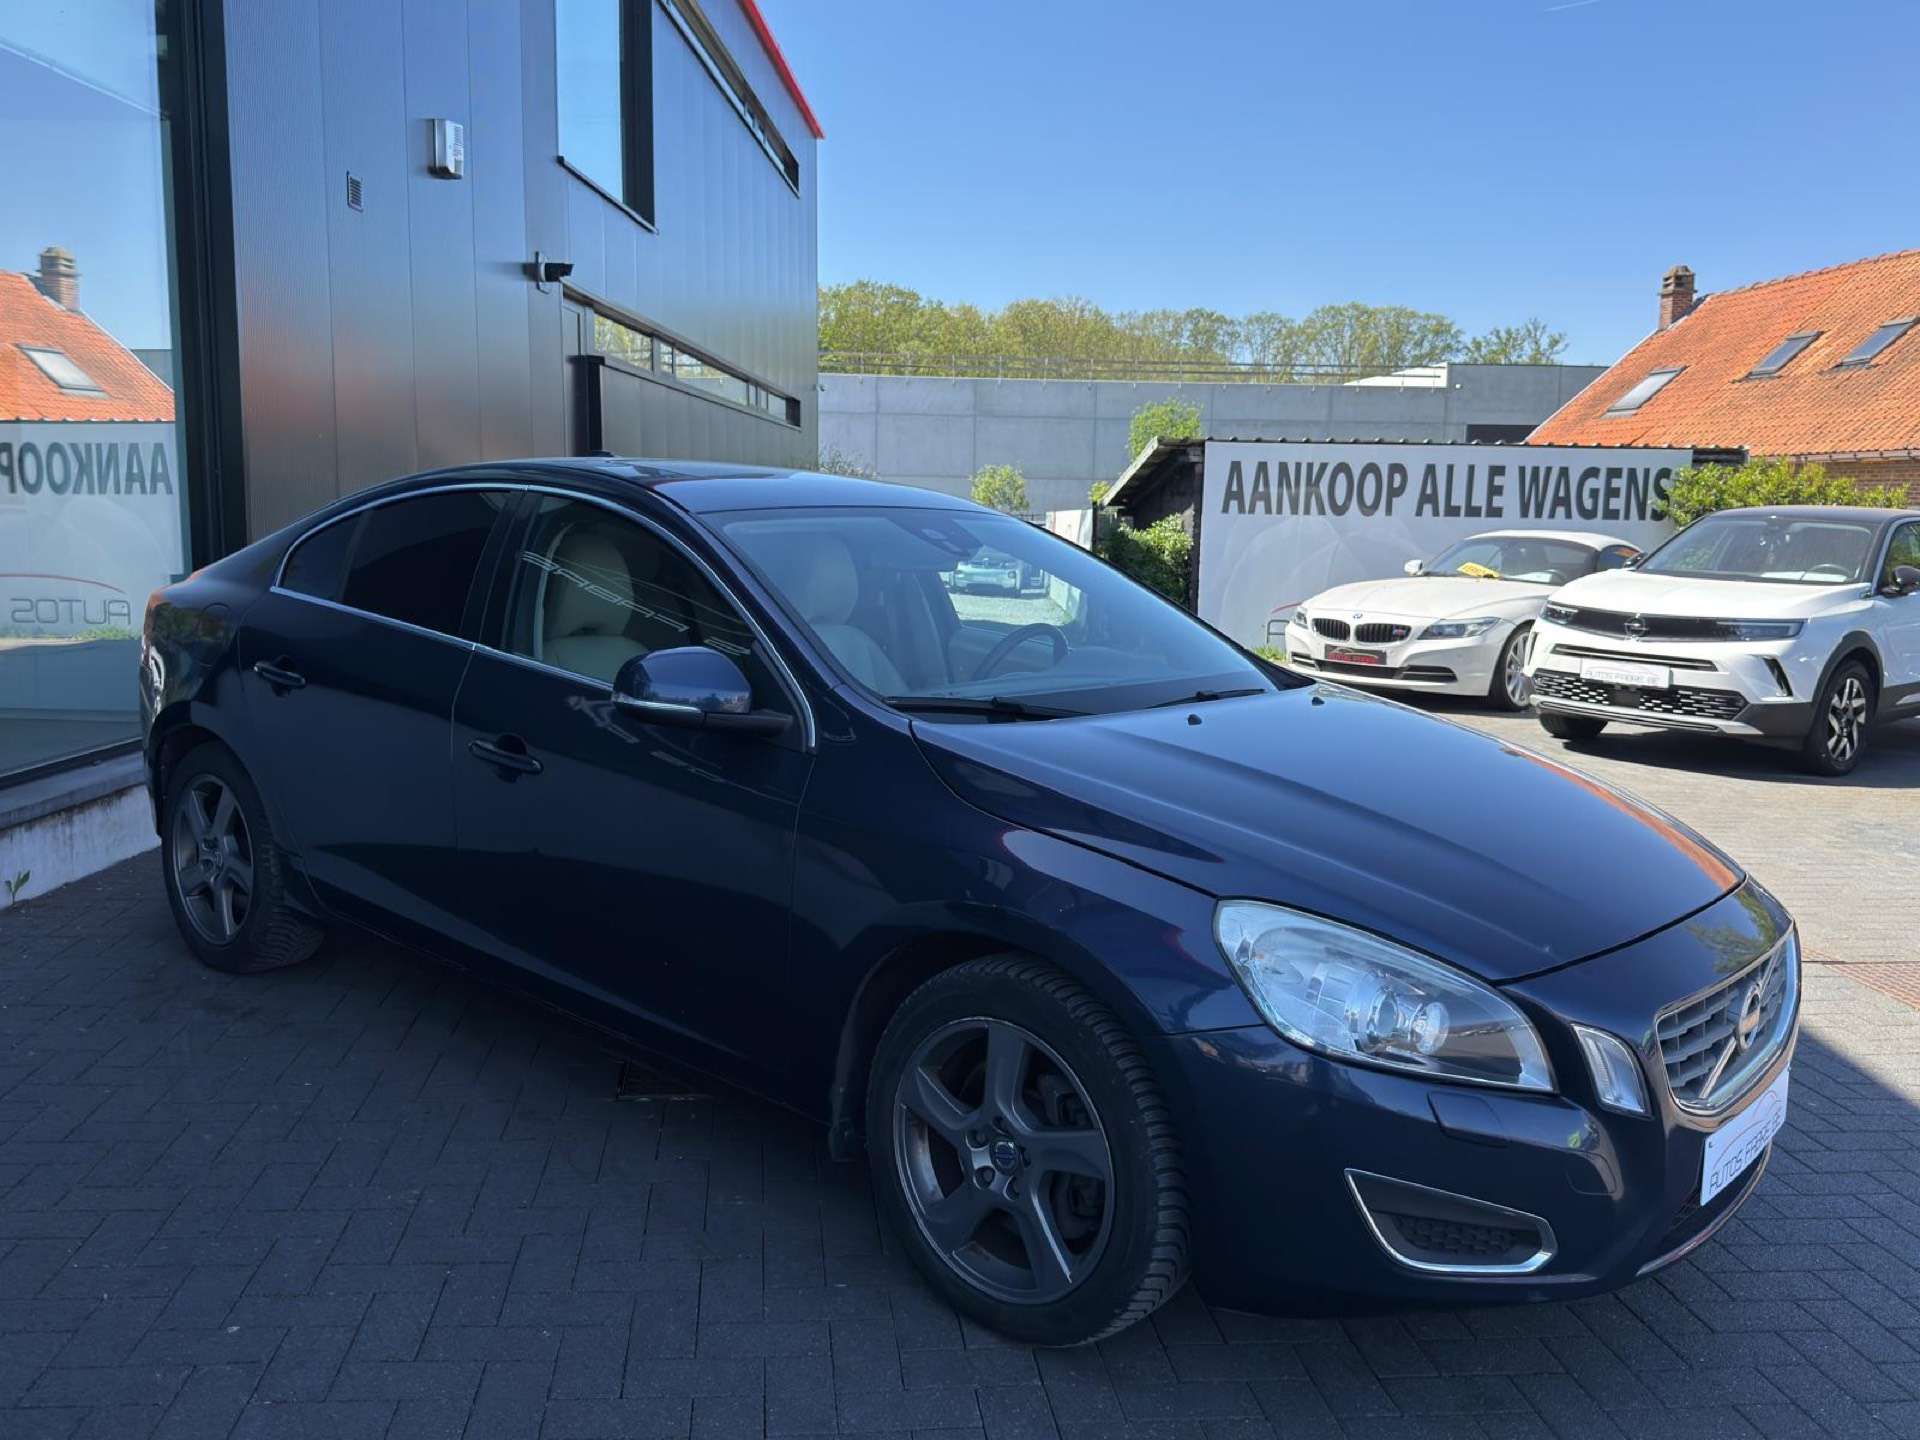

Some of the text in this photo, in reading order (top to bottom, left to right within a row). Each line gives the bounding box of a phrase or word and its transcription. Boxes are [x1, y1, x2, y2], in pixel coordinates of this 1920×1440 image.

[1221, 460, 1672, 521] AANKOOP ALLE WAGENS
